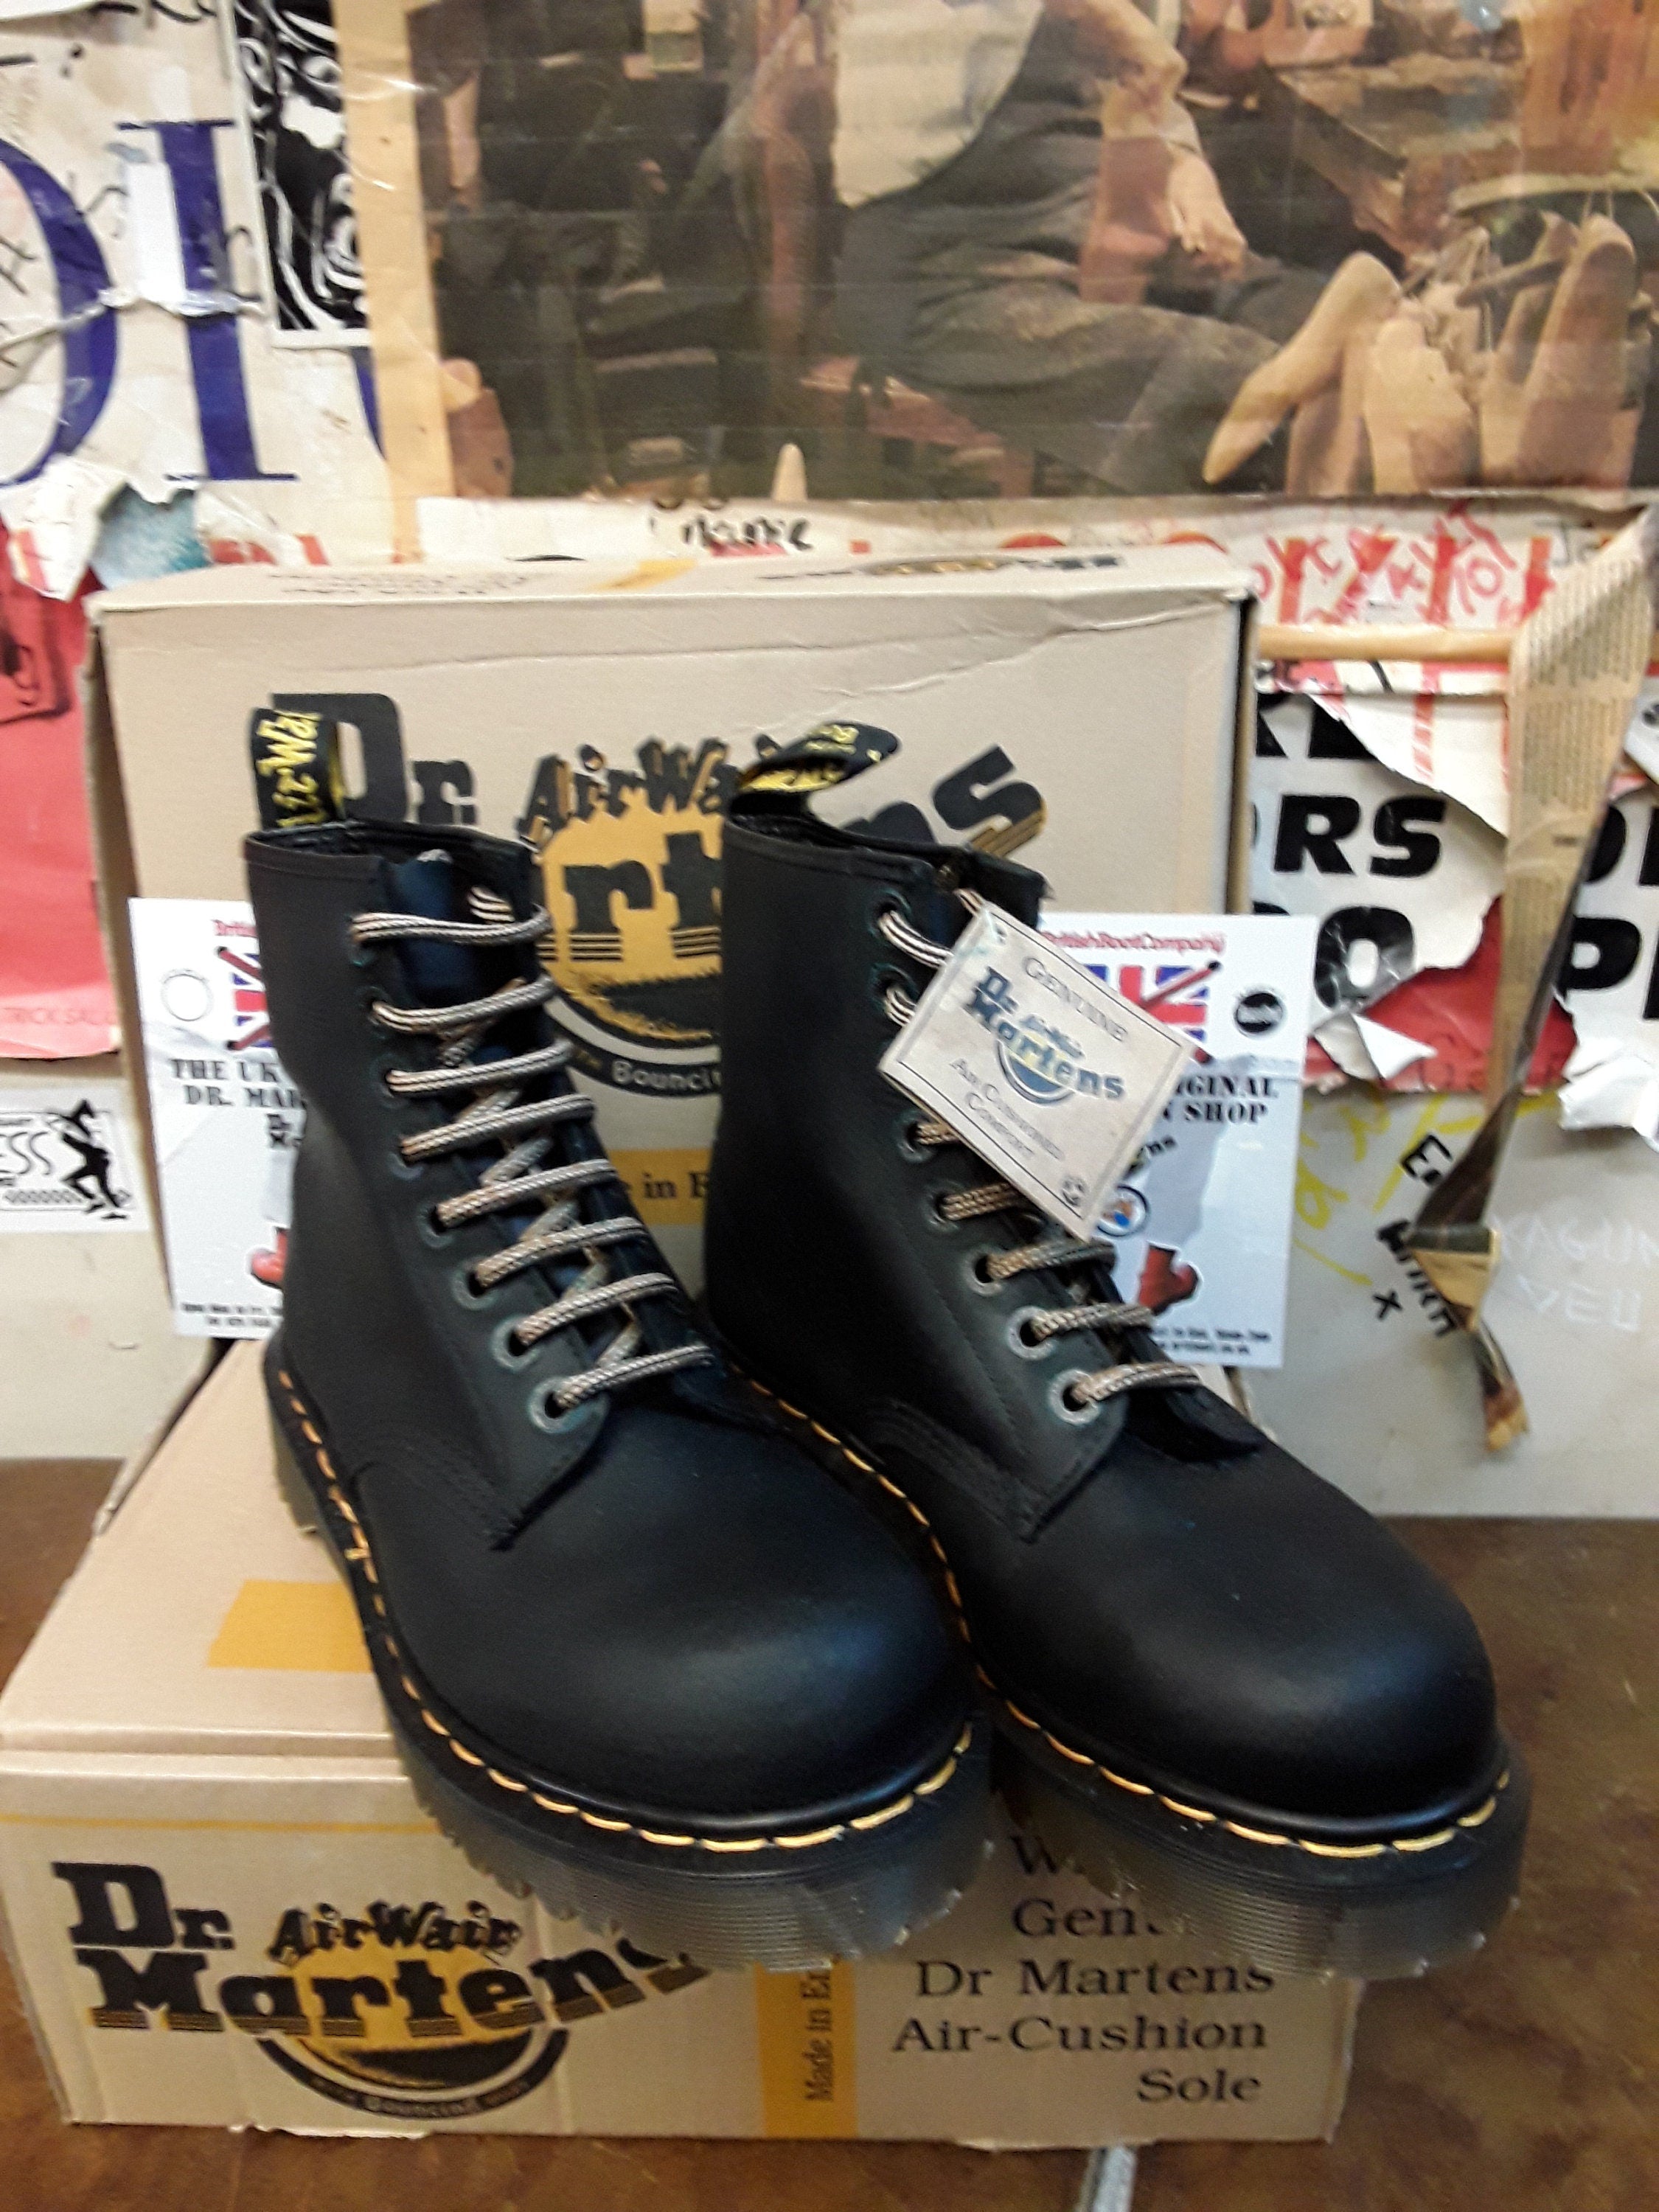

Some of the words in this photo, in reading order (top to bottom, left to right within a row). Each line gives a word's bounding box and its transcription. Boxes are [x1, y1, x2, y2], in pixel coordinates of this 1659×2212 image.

[962, 988, 1125, 1099] Martens
[170, 1057, 229, 1081] THE
[1184, 1102, 1268, 1124] SHOP
[265, 1899, 521, 1964] AirWair
[915, 1959, 992, 1996] Dr
[1018, 1958, 1276, 1996] Martens
[804, 2008, 832, 2032] in
[891, 2014, 1268, 2052] Air-Cushion
[800, 2037, 833, 2101] Made
[1135, 2067, 1262, 2104] Sole
